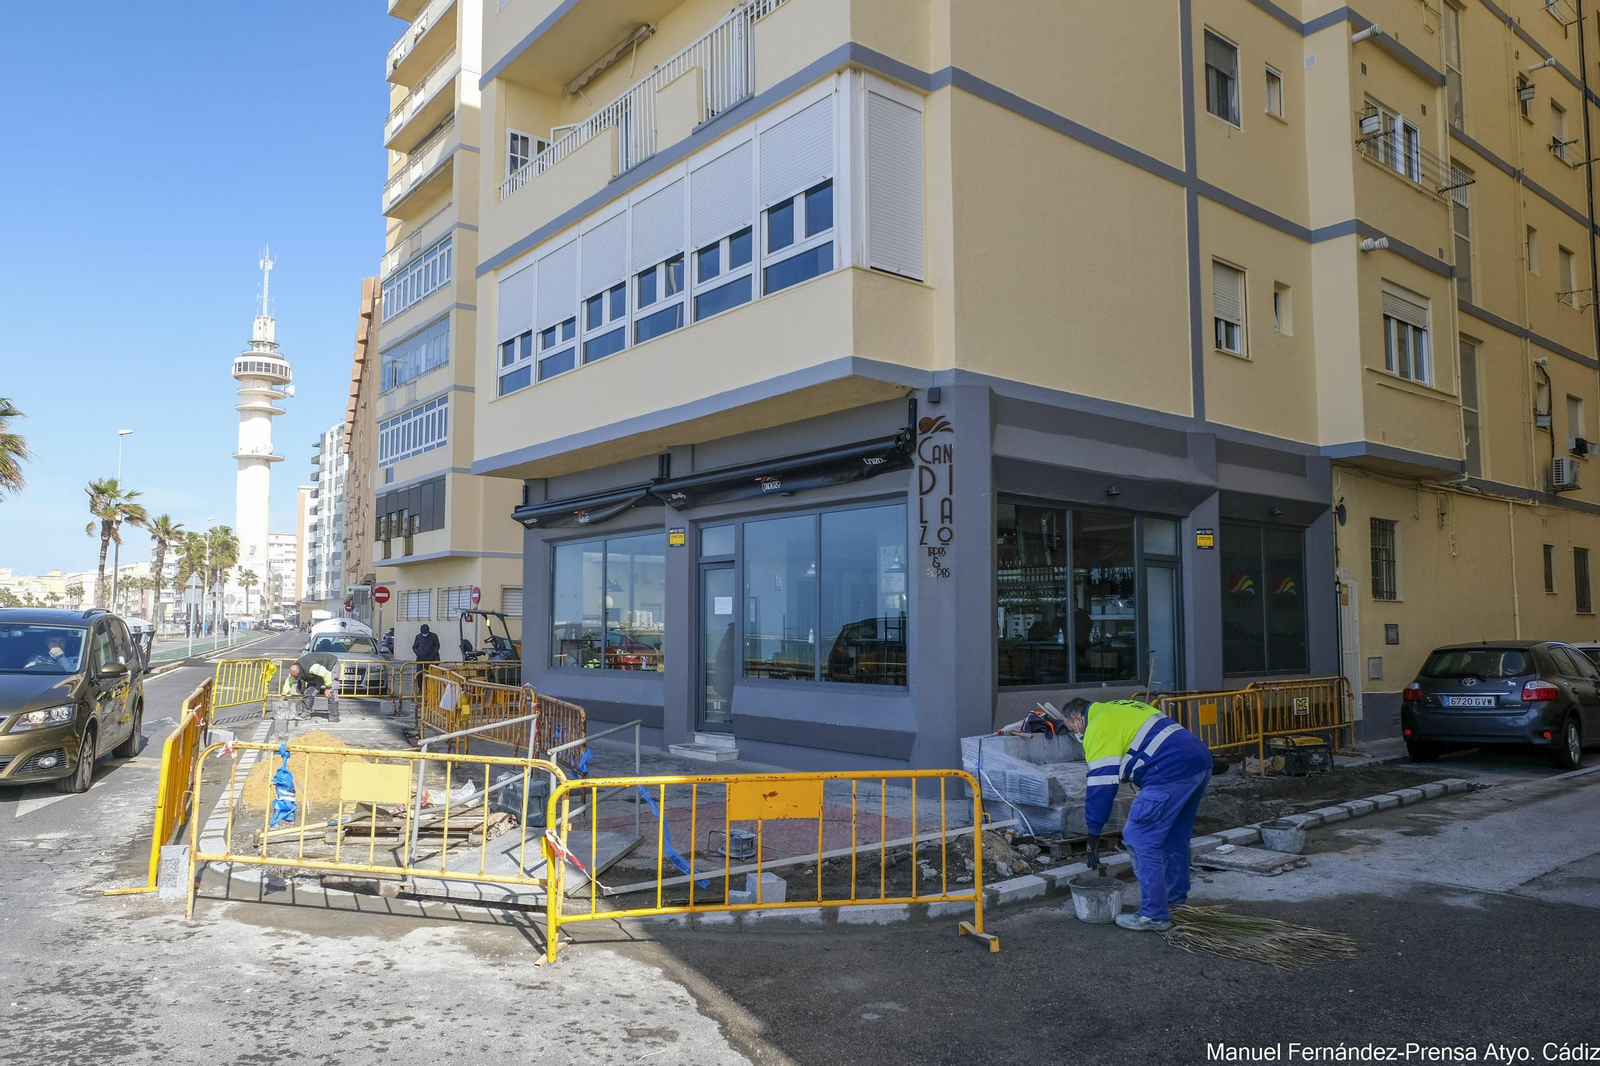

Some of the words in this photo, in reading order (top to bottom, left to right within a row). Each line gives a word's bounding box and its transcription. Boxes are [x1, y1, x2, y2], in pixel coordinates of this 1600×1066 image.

[927, 546, 947, 557] TAPAS
[932, 556, 941, 568] &
[1450, 696, 1472, 706] 6720
[1475, 696, 1493, 706] GVW
